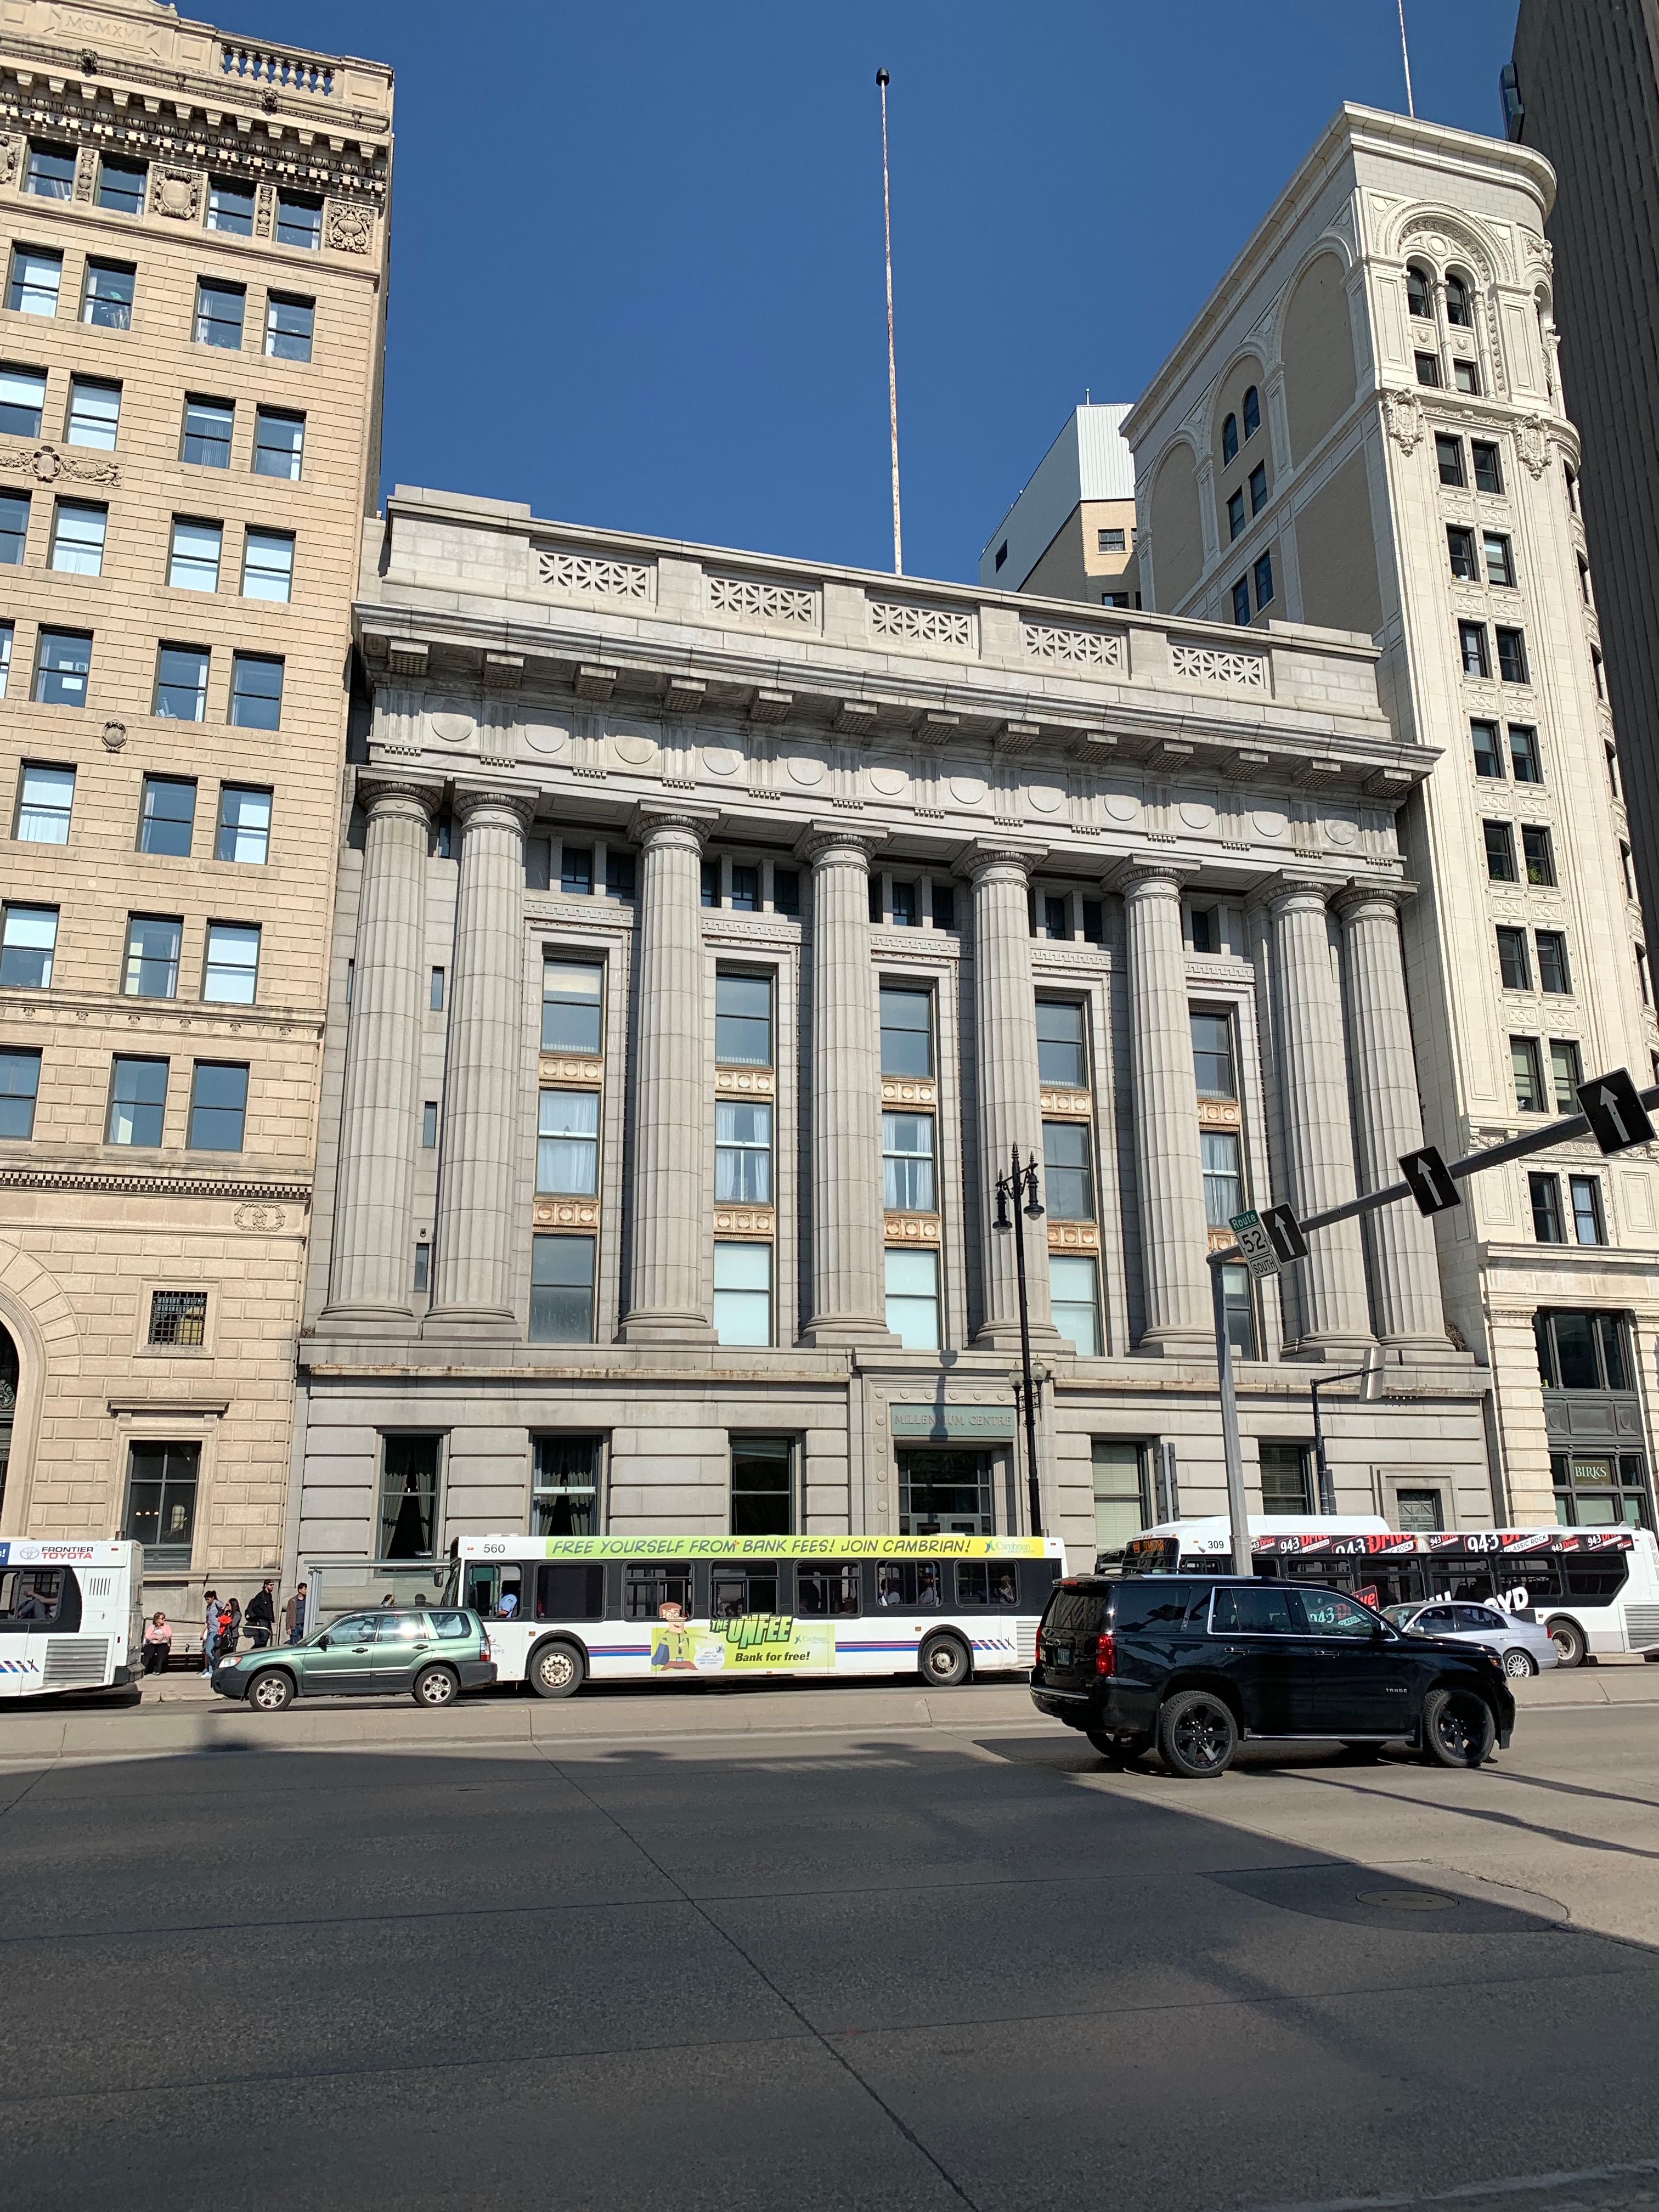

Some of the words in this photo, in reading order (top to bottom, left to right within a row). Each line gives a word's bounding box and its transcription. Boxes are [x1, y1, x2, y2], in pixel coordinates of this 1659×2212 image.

[65, 15, 141, 41] MCMXVI
[1232, 1214, 1256, 1229] Route
[1242, 1231, 1266, 1252] 52
[1253, 1259, 1276, 1274] SOUTH
[895, 1414, 964, 1425] MILLENNIUM
[969, 1416, 1012, 1426] CENTRE
[1575, 1466, 1607, 1480] BIRKS
[1208, 1541, 1224, 1549] 309
[1531, 1534, 1547, 1545] ROCK
[483, 1543, 506, 1554] 560
[552, 1541, 595, 1554] FREE
[600, 1540, 685, 1554] YOURSELF
[689, 1539, 736, 1554] FROM
[742, 1539, 787, 1553] BANK
[792, 1539, 835, 1553] FEES!
[841, 1539, 879, 1553] JOIN
[883, 1539, 971, 1553] CAMBRIAN!
[996, 1542, 1031, 1550] Cambrian
[1303, 1543, 1318, 1552] CLASSIC
[1396, 1543, 1412, 1553] ROCK
[710, 1620, 729, 1631] THE
[726, 1613, 793, 1649] UNFEE
[735, 1652, 763, 1662] Bank
[766, 1652, 782, 1661] for
[784, 1651, 810, 1661] free!
